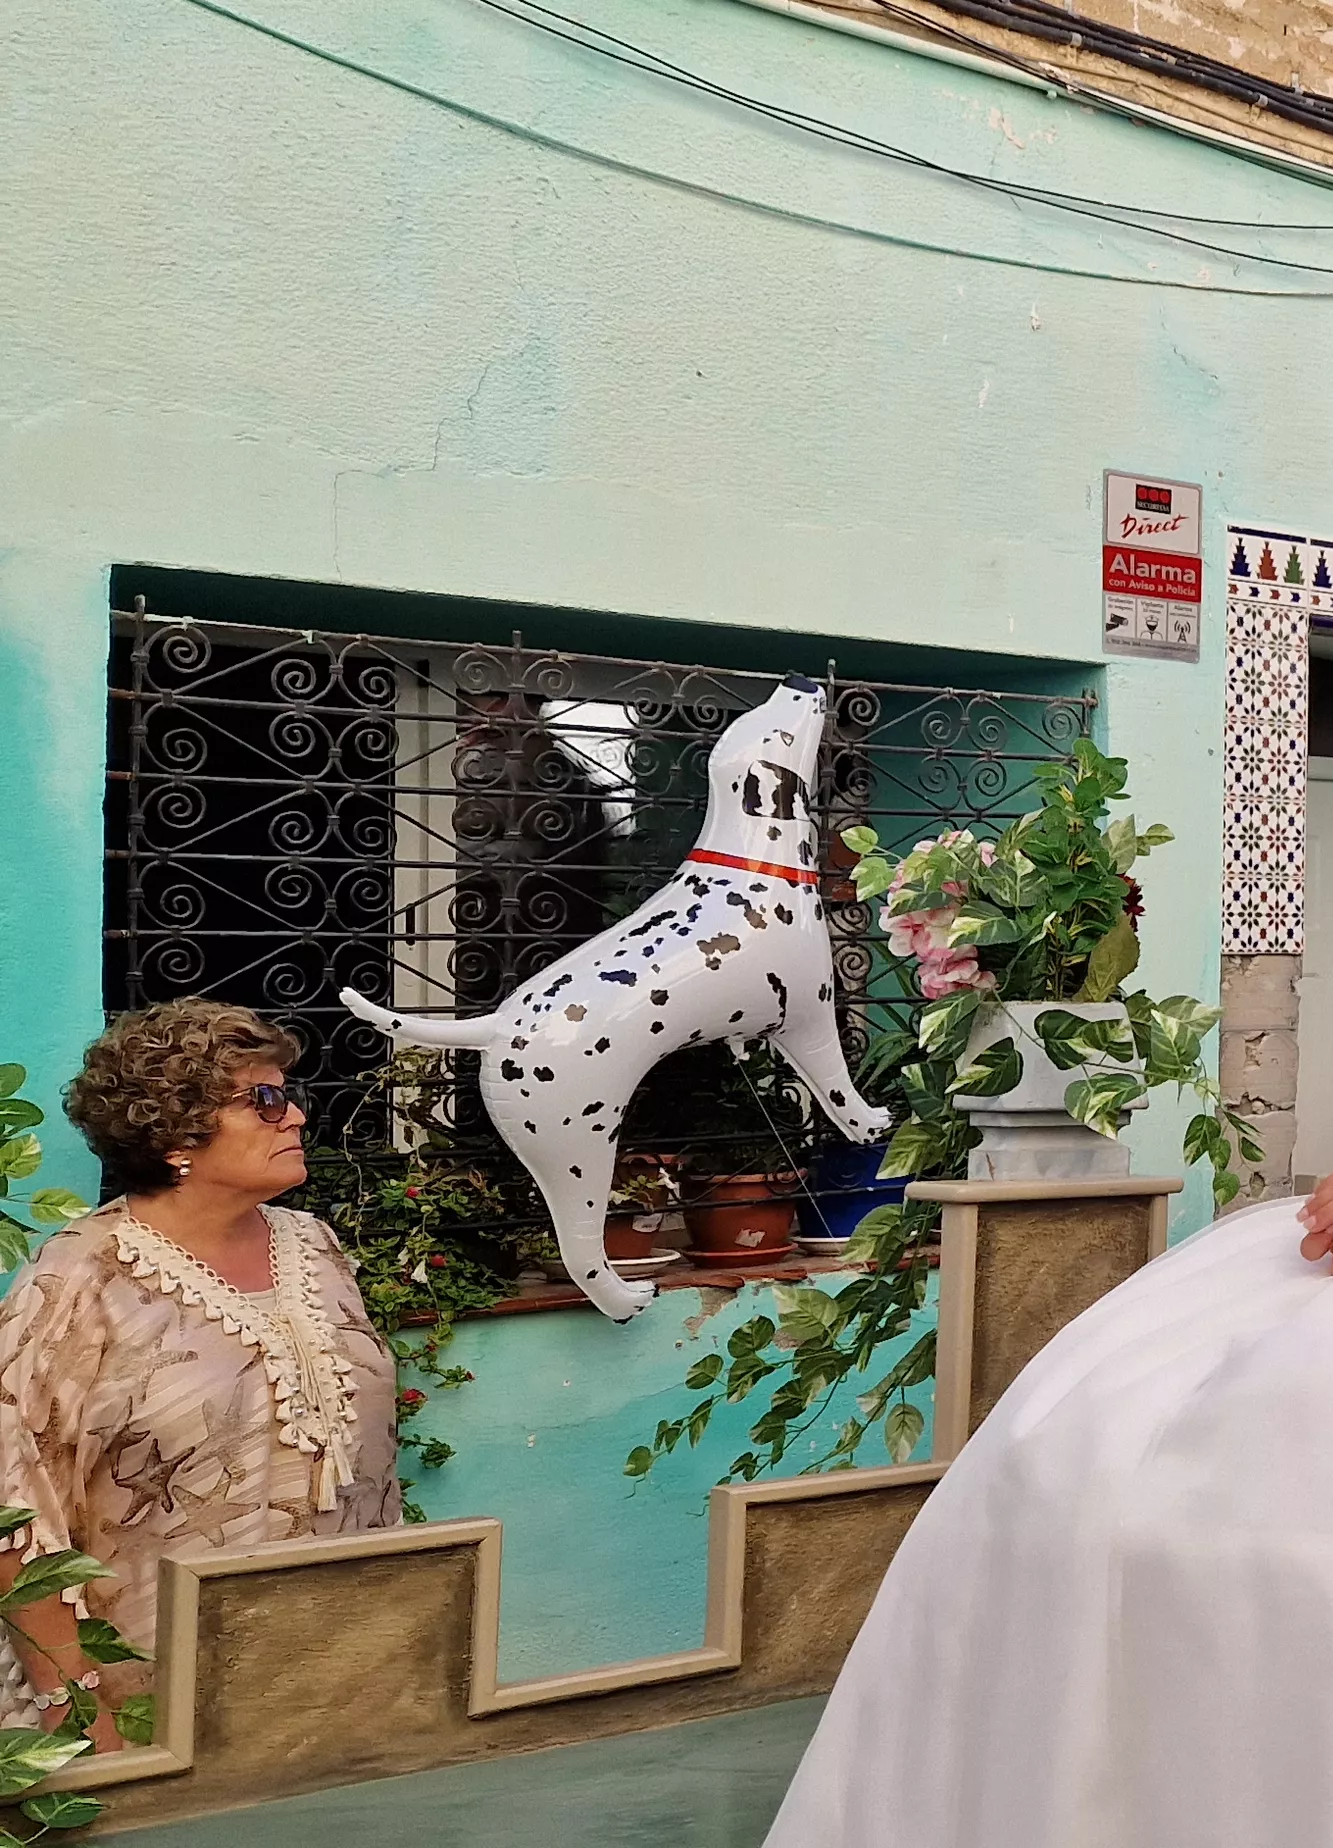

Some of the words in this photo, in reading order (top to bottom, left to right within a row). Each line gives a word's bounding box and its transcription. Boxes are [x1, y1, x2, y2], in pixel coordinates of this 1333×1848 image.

[1119, 513, 1190, 539] Direct
[1108, 553, 1196, 584] Alarma
[1108, 578, 1126, 588] con
[1128, 579, 1155, 591] Aviso
[1157, 584, 1164, 593] a
